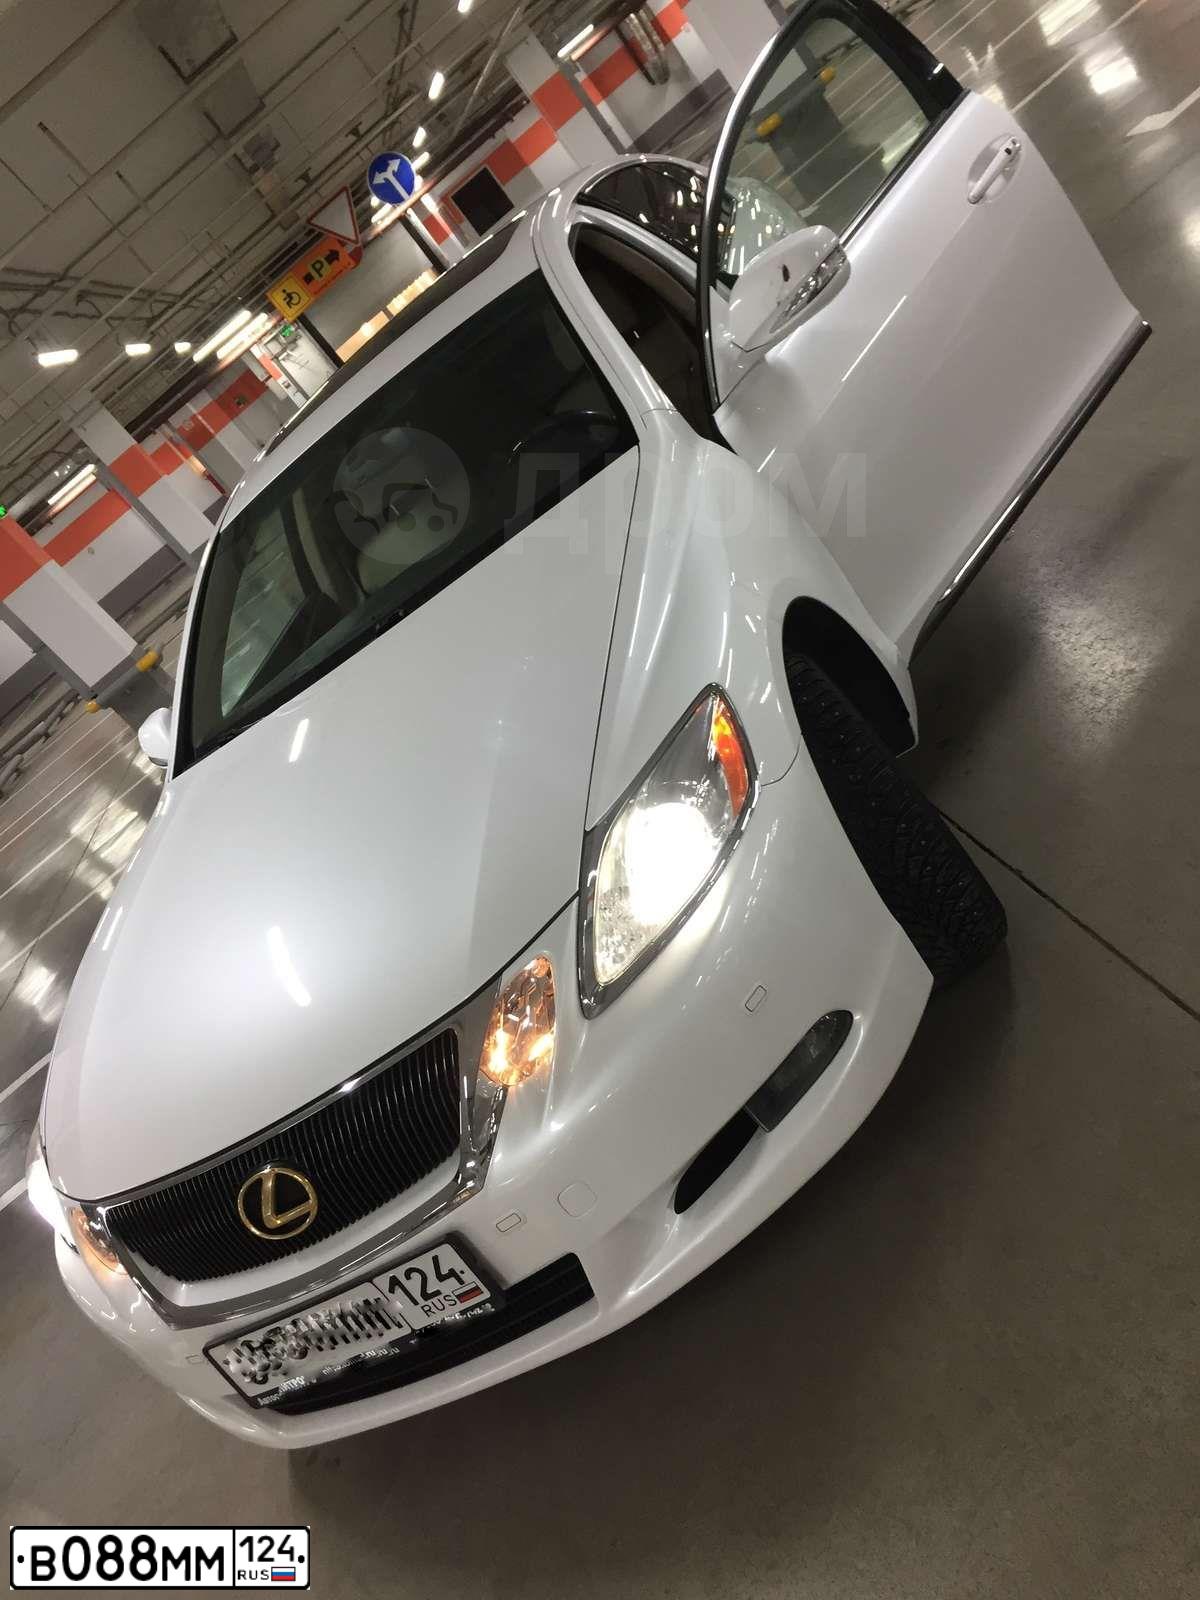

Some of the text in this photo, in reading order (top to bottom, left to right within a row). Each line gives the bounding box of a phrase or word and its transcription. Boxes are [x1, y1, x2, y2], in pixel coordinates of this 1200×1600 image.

[311, 260, 324, 278] P
[388, 1255, 465, 1306] 124
[420, 1294, 457, 1318] RUS
